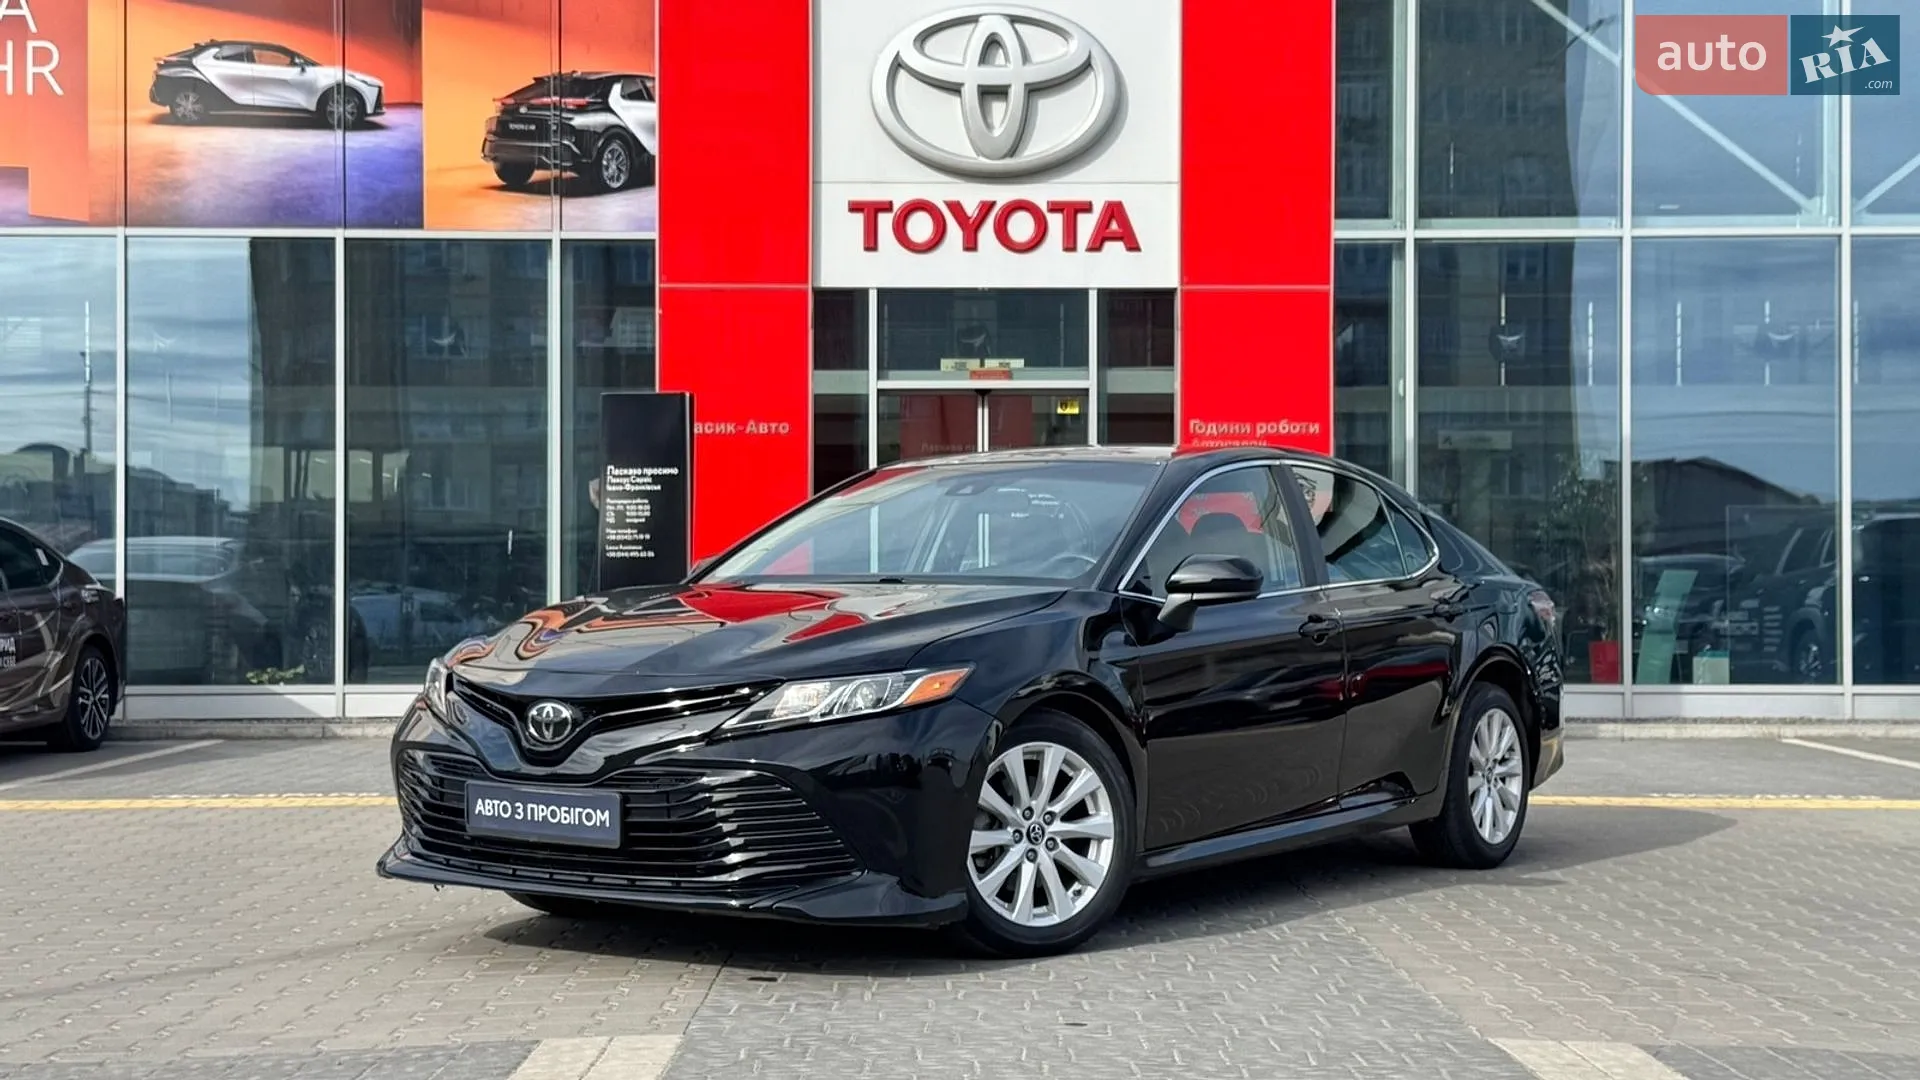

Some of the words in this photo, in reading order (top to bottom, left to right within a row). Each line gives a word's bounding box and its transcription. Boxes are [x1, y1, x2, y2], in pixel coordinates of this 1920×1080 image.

[848, 198, 1142, 254] TOYOTA
[1189, 418, 1251, 436] Години
[1255, 418, 1320, 438] роботи
[475, 798, 512, 819] АВТО
[527, 803, 610, 828] ПРОБІГОМ
